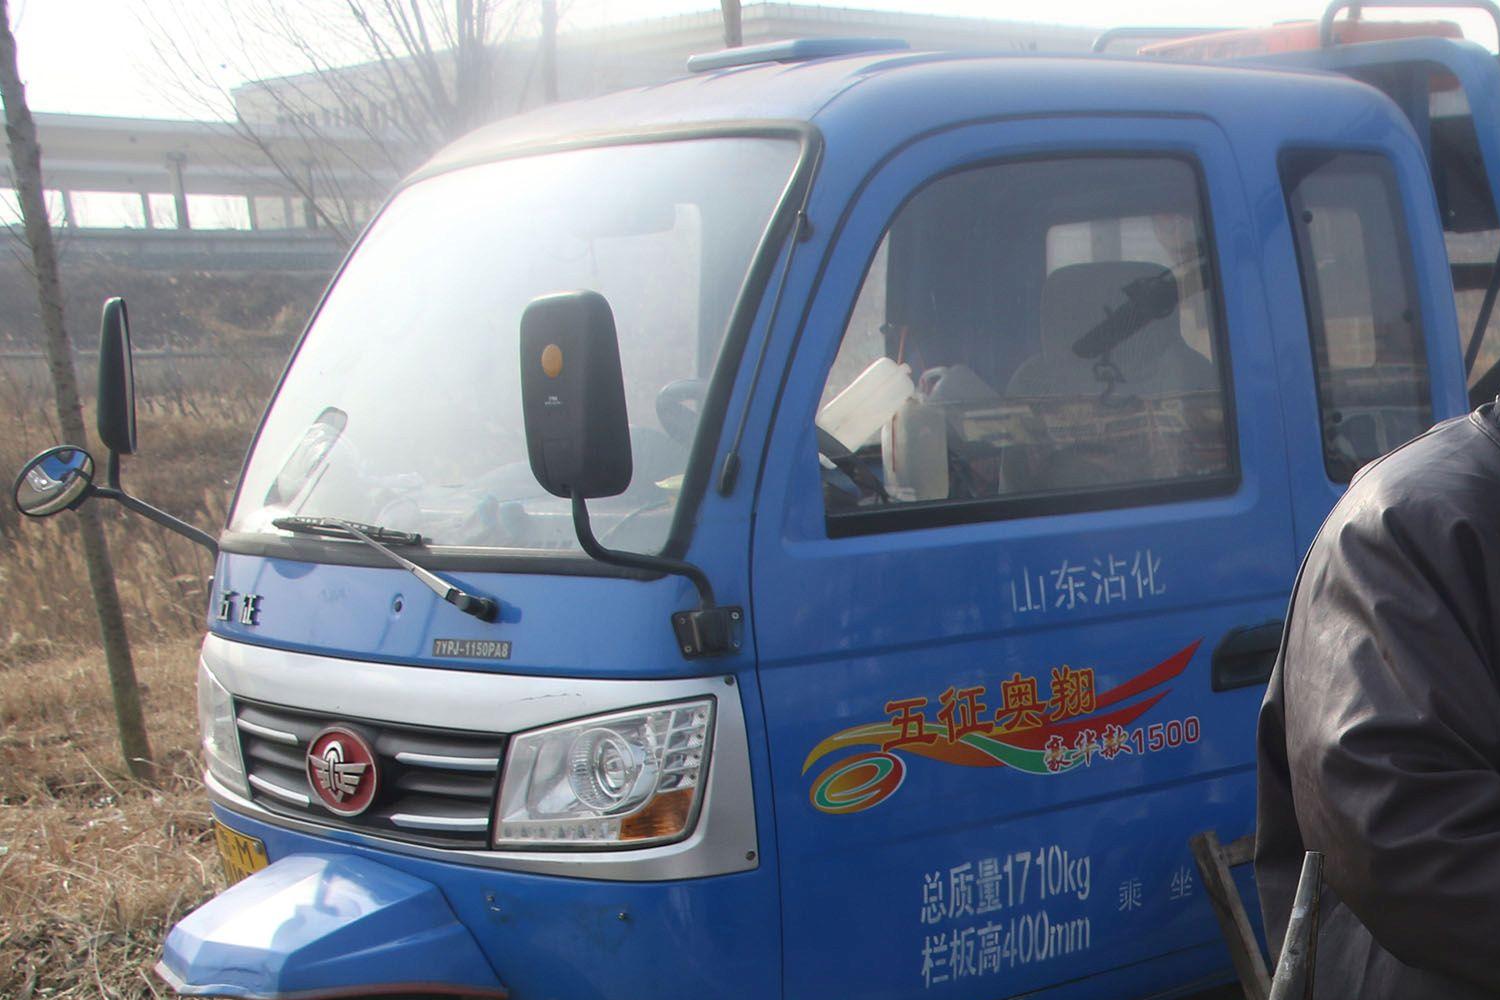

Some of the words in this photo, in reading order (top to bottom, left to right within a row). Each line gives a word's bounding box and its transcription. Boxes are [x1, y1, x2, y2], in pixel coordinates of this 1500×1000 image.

[1010, 548, 1167, 613] 山东沾化
[434, 640, 510, 658] 7YPJ-1150PA8
[881, 664, 1097, 753] 五征奥翔
[920, 844, 1092, 925] 总质量1710kg
[921, 909, 1091, 990] 栏板高400mm
